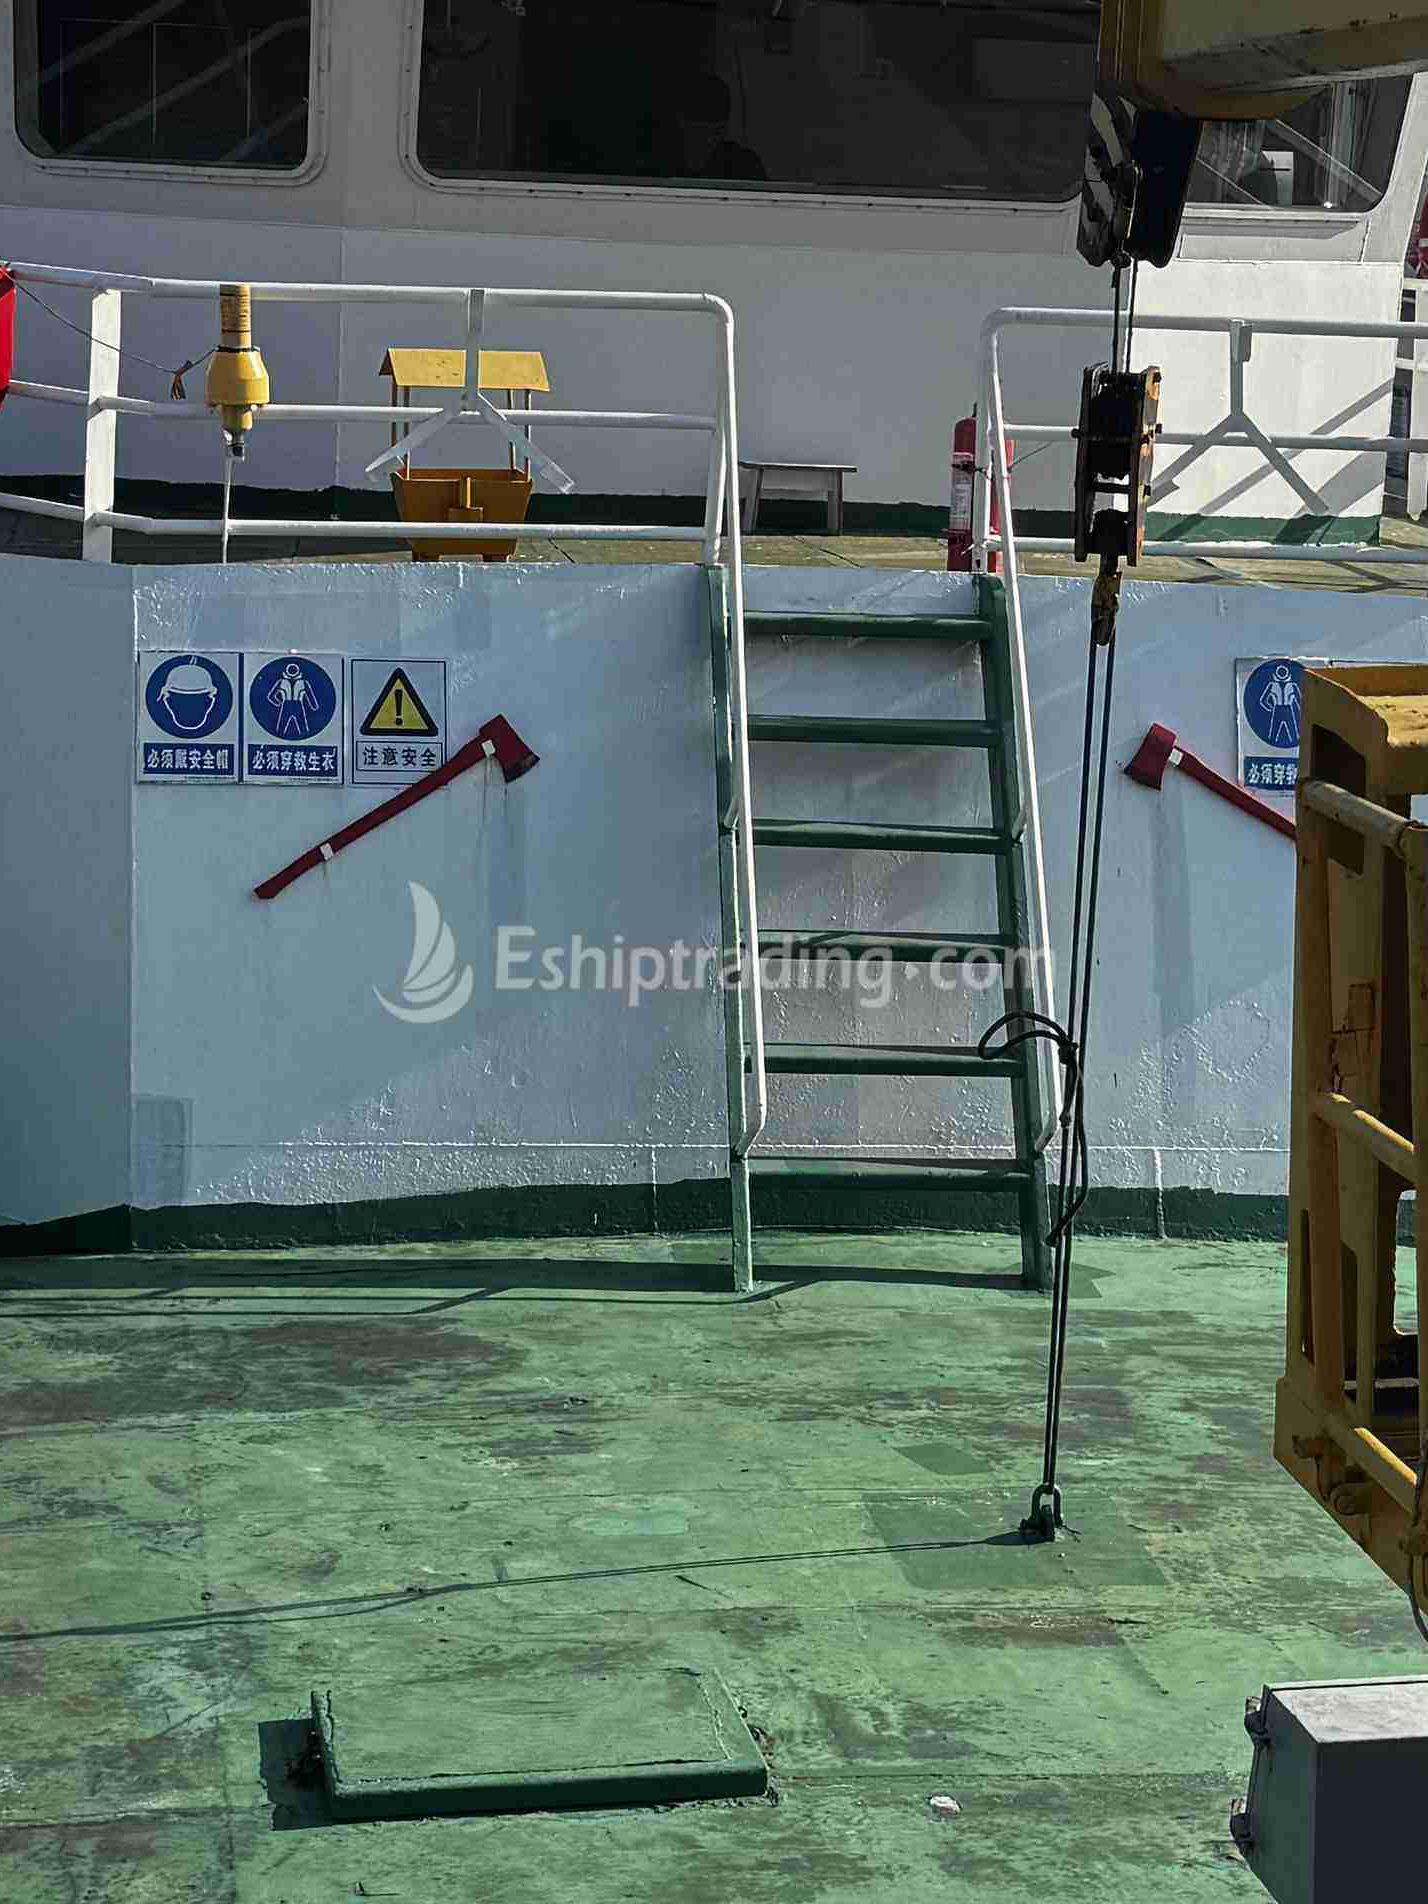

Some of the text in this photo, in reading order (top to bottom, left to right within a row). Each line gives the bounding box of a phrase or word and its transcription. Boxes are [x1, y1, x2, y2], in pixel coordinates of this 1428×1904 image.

[147, 748, 229, 770] 必须戴安全帽
[252, 749, 337, 772] 必须穿救生衣
[363, 745, 437, 767] 注意安全
